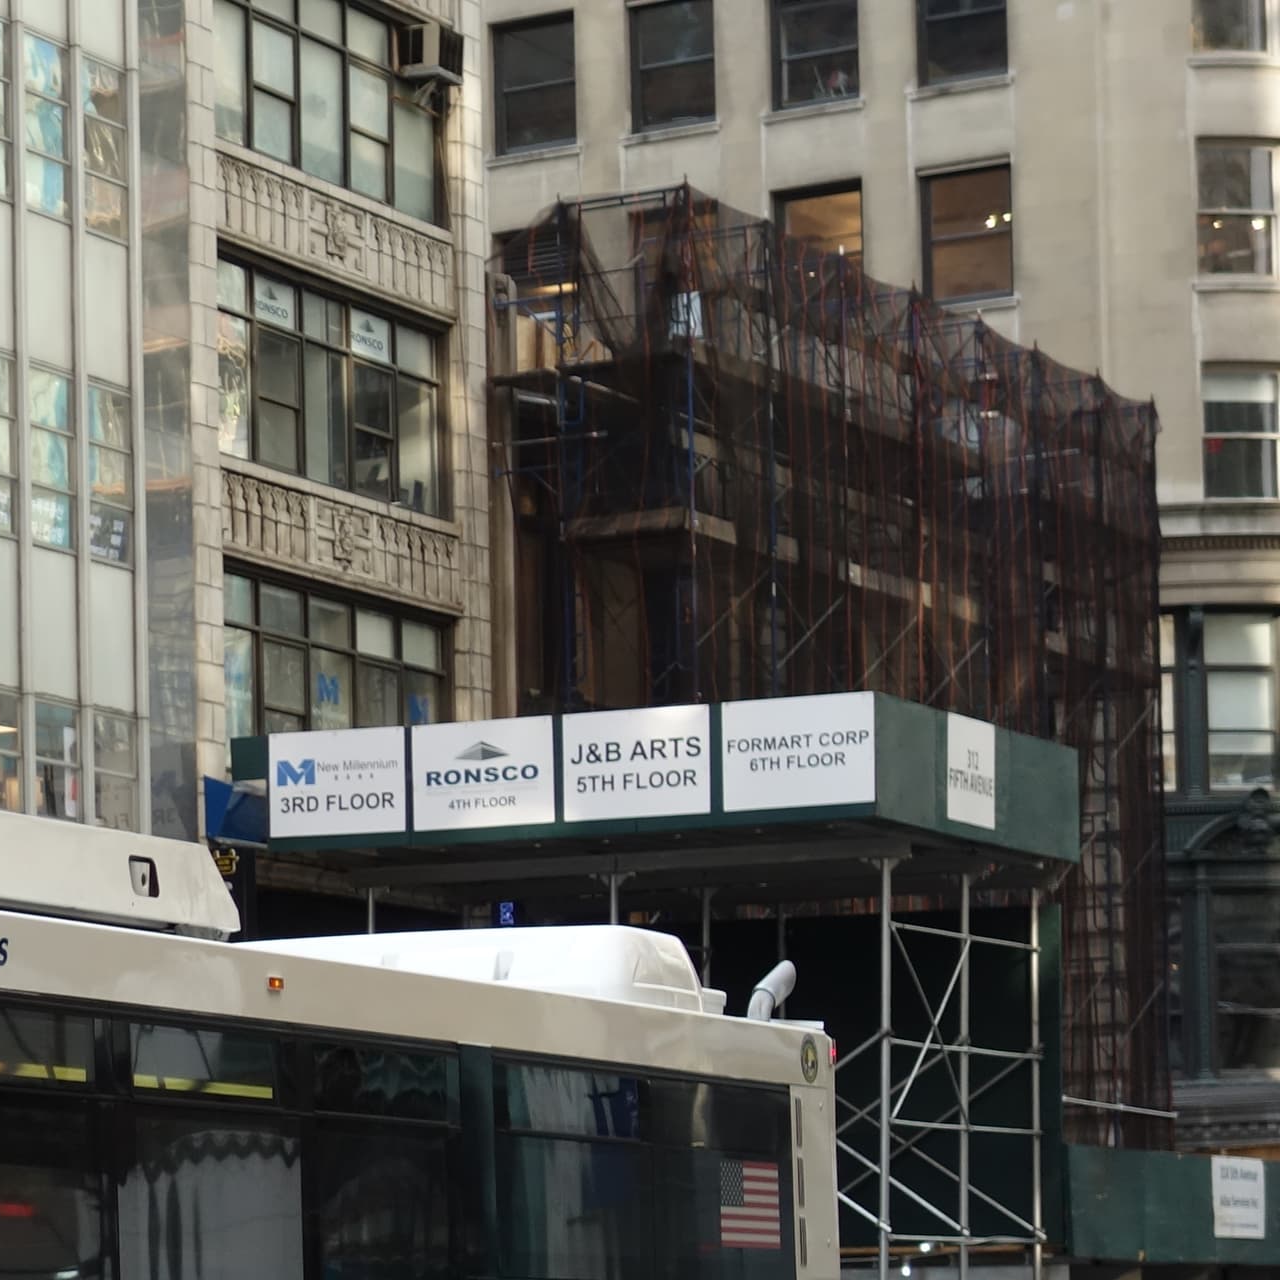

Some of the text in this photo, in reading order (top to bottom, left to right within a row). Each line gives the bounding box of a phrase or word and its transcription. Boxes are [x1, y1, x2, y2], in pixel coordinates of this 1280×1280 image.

[570, 736, 702, 766] J&B ARTS
[727, 730, 870, 755] FORMART CORP
[749, 751, 846, 772] 6TH FLOOR
[426, 764, 539, 787] RONSCO
[576, 769, 697, 794] 5TH FLOOR
[280, 792, 395, 814] 3RD FLOOR
[448, 796, 516, 811] 4TH FLOOR
